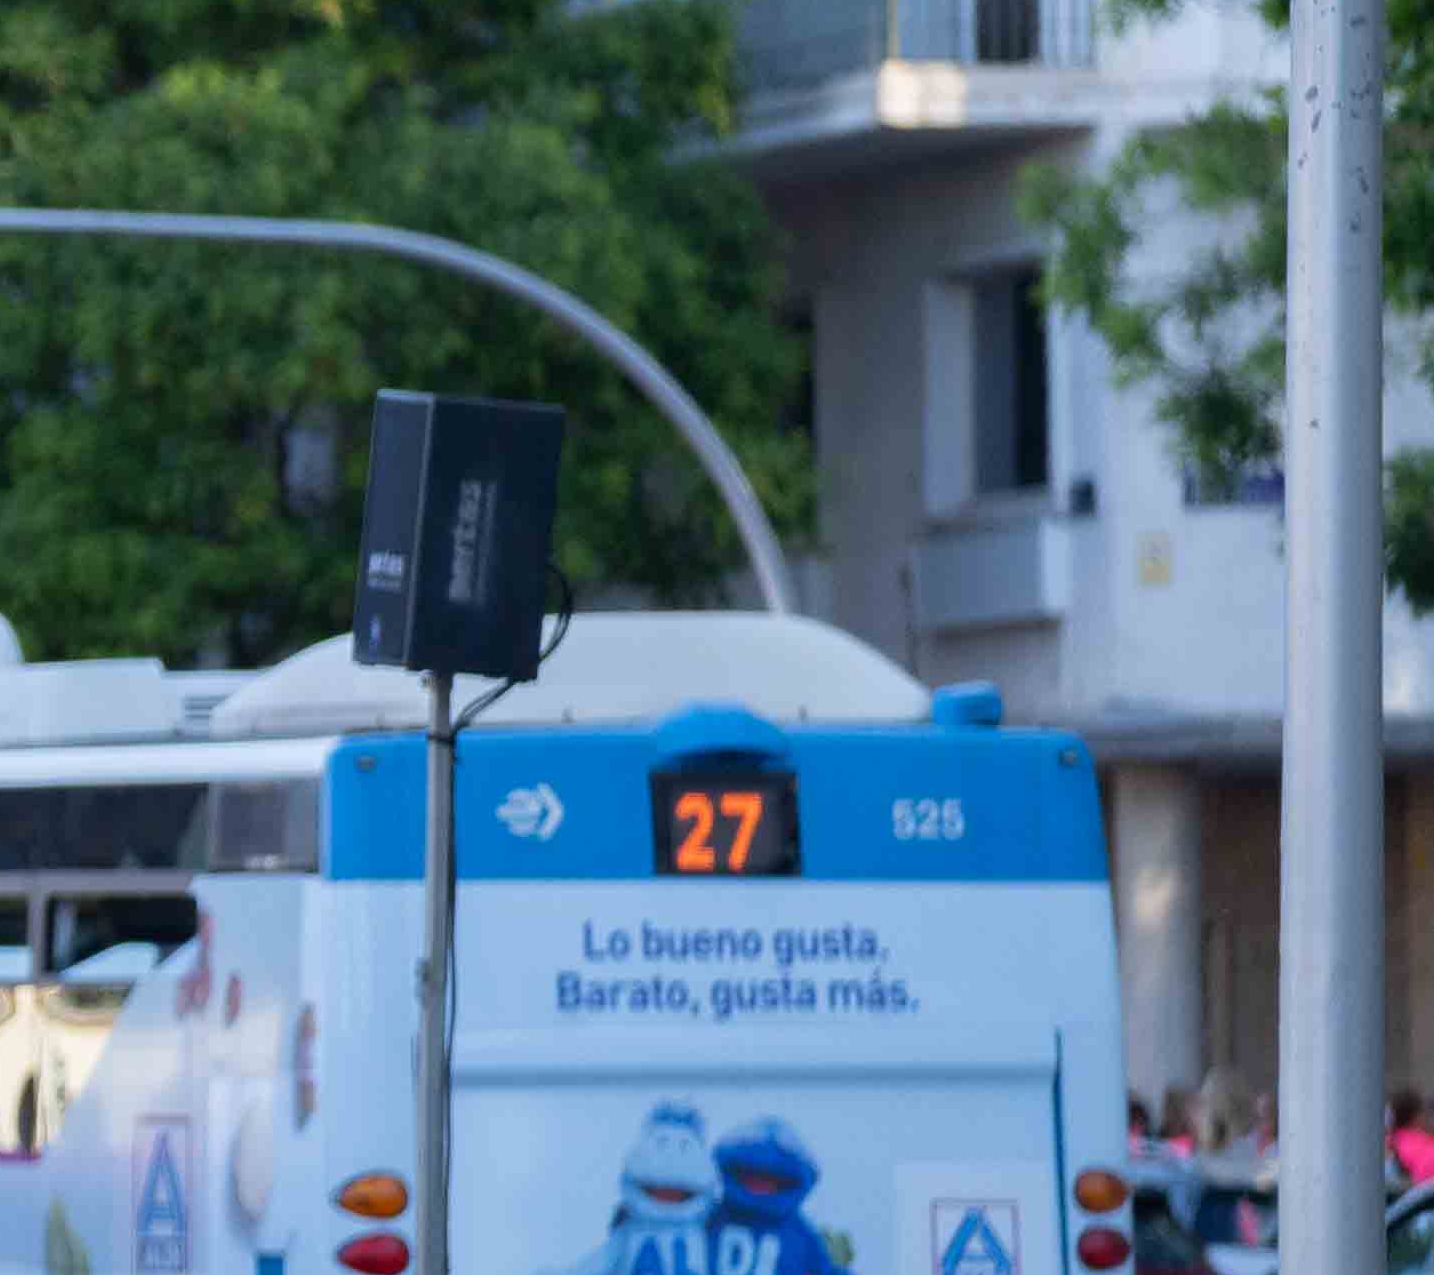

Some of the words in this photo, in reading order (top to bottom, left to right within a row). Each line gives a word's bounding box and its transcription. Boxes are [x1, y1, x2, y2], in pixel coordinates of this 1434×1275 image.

[674, 793, 765, 873] 27
[893, 799, 966, 840] 525
[582, 919, 631, 961] Lo
[641, 918, 763, 961] bueno
[773, 923, 889, 967] gusta.
[555, 970, 701, 1017] Barato,
[710, 973, 817, 1023] gusta
[828, 966, 920, 1012] más.
